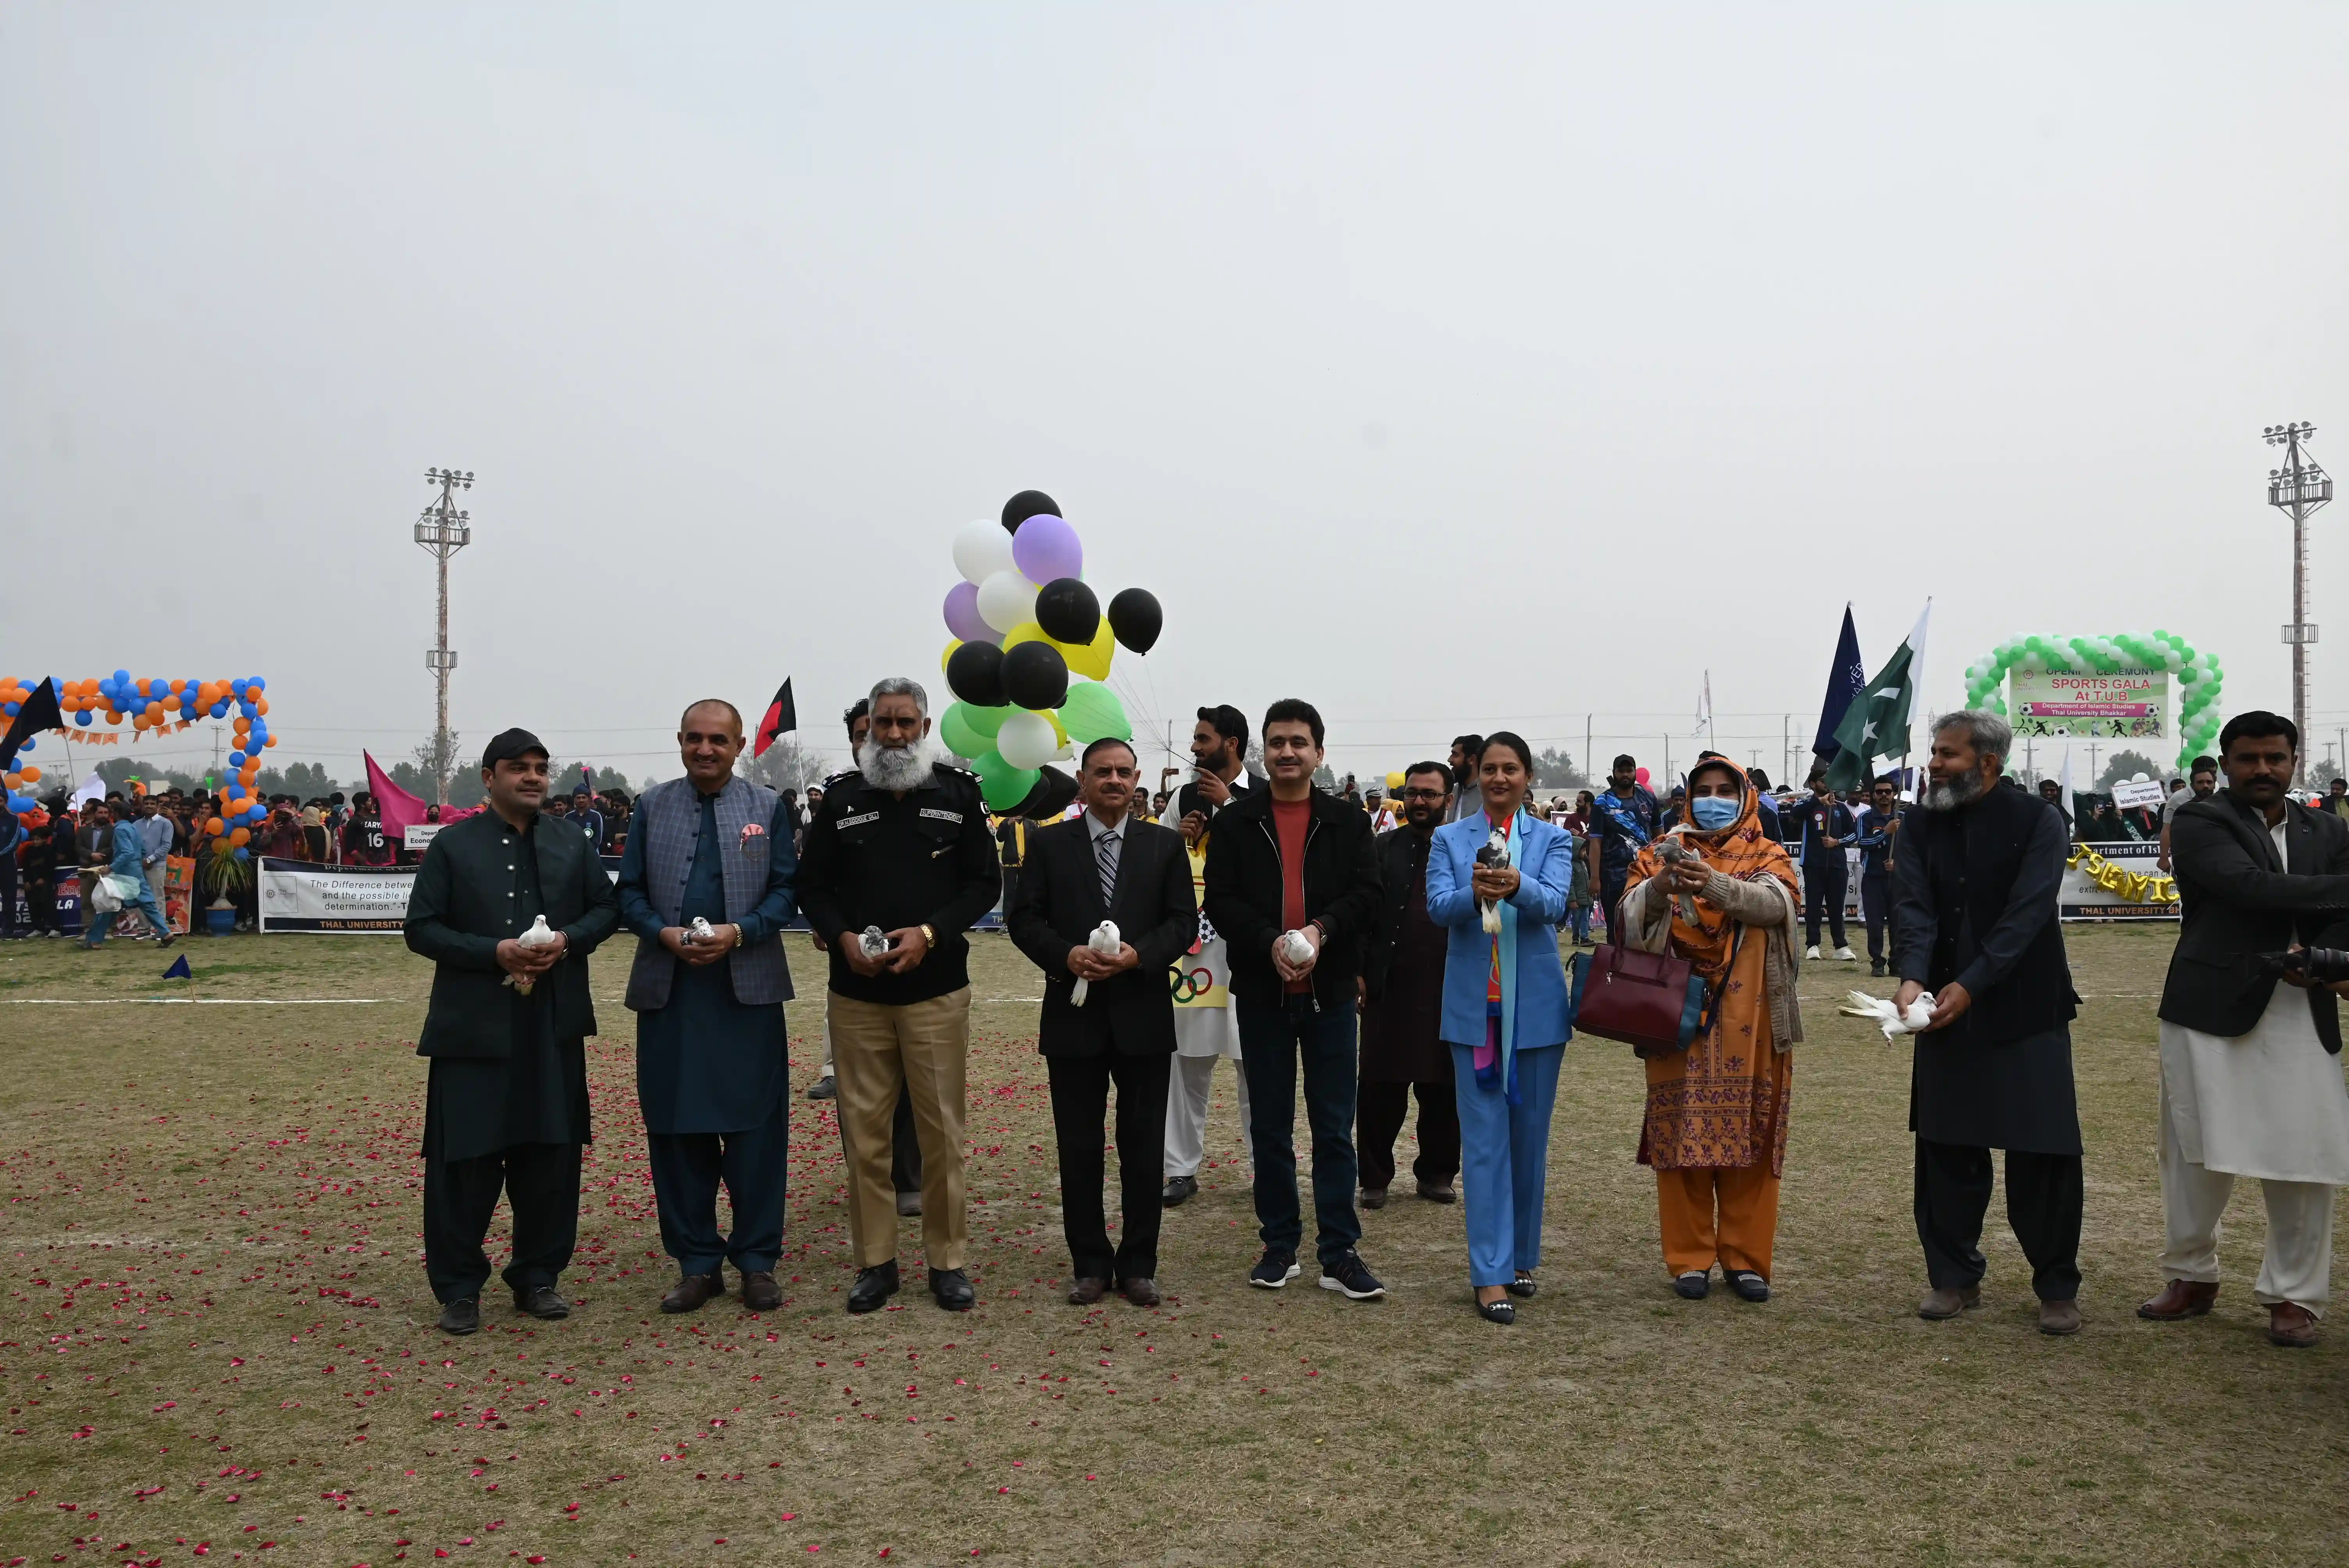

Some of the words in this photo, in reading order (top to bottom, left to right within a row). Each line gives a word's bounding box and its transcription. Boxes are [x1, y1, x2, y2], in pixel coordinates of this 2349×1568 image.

[2052, 679, 2108, 689] SPORTS
[2112, 679, 2151, 689] GALA
[2075, 691, 2089, 701] At
[2093, 691, 2128, 701] T.U.B
[921, 810, 961, 821] SUPERINTENDENT
[367, 832, 384, 848] 16
[2072, 846, 2134, 855] Dartment
[2136, 845, 2146, 854] of
[310, 880, 328, 888] The
[331, 880, 382, 889] Difference
[359, 891, 400, 901] possible
